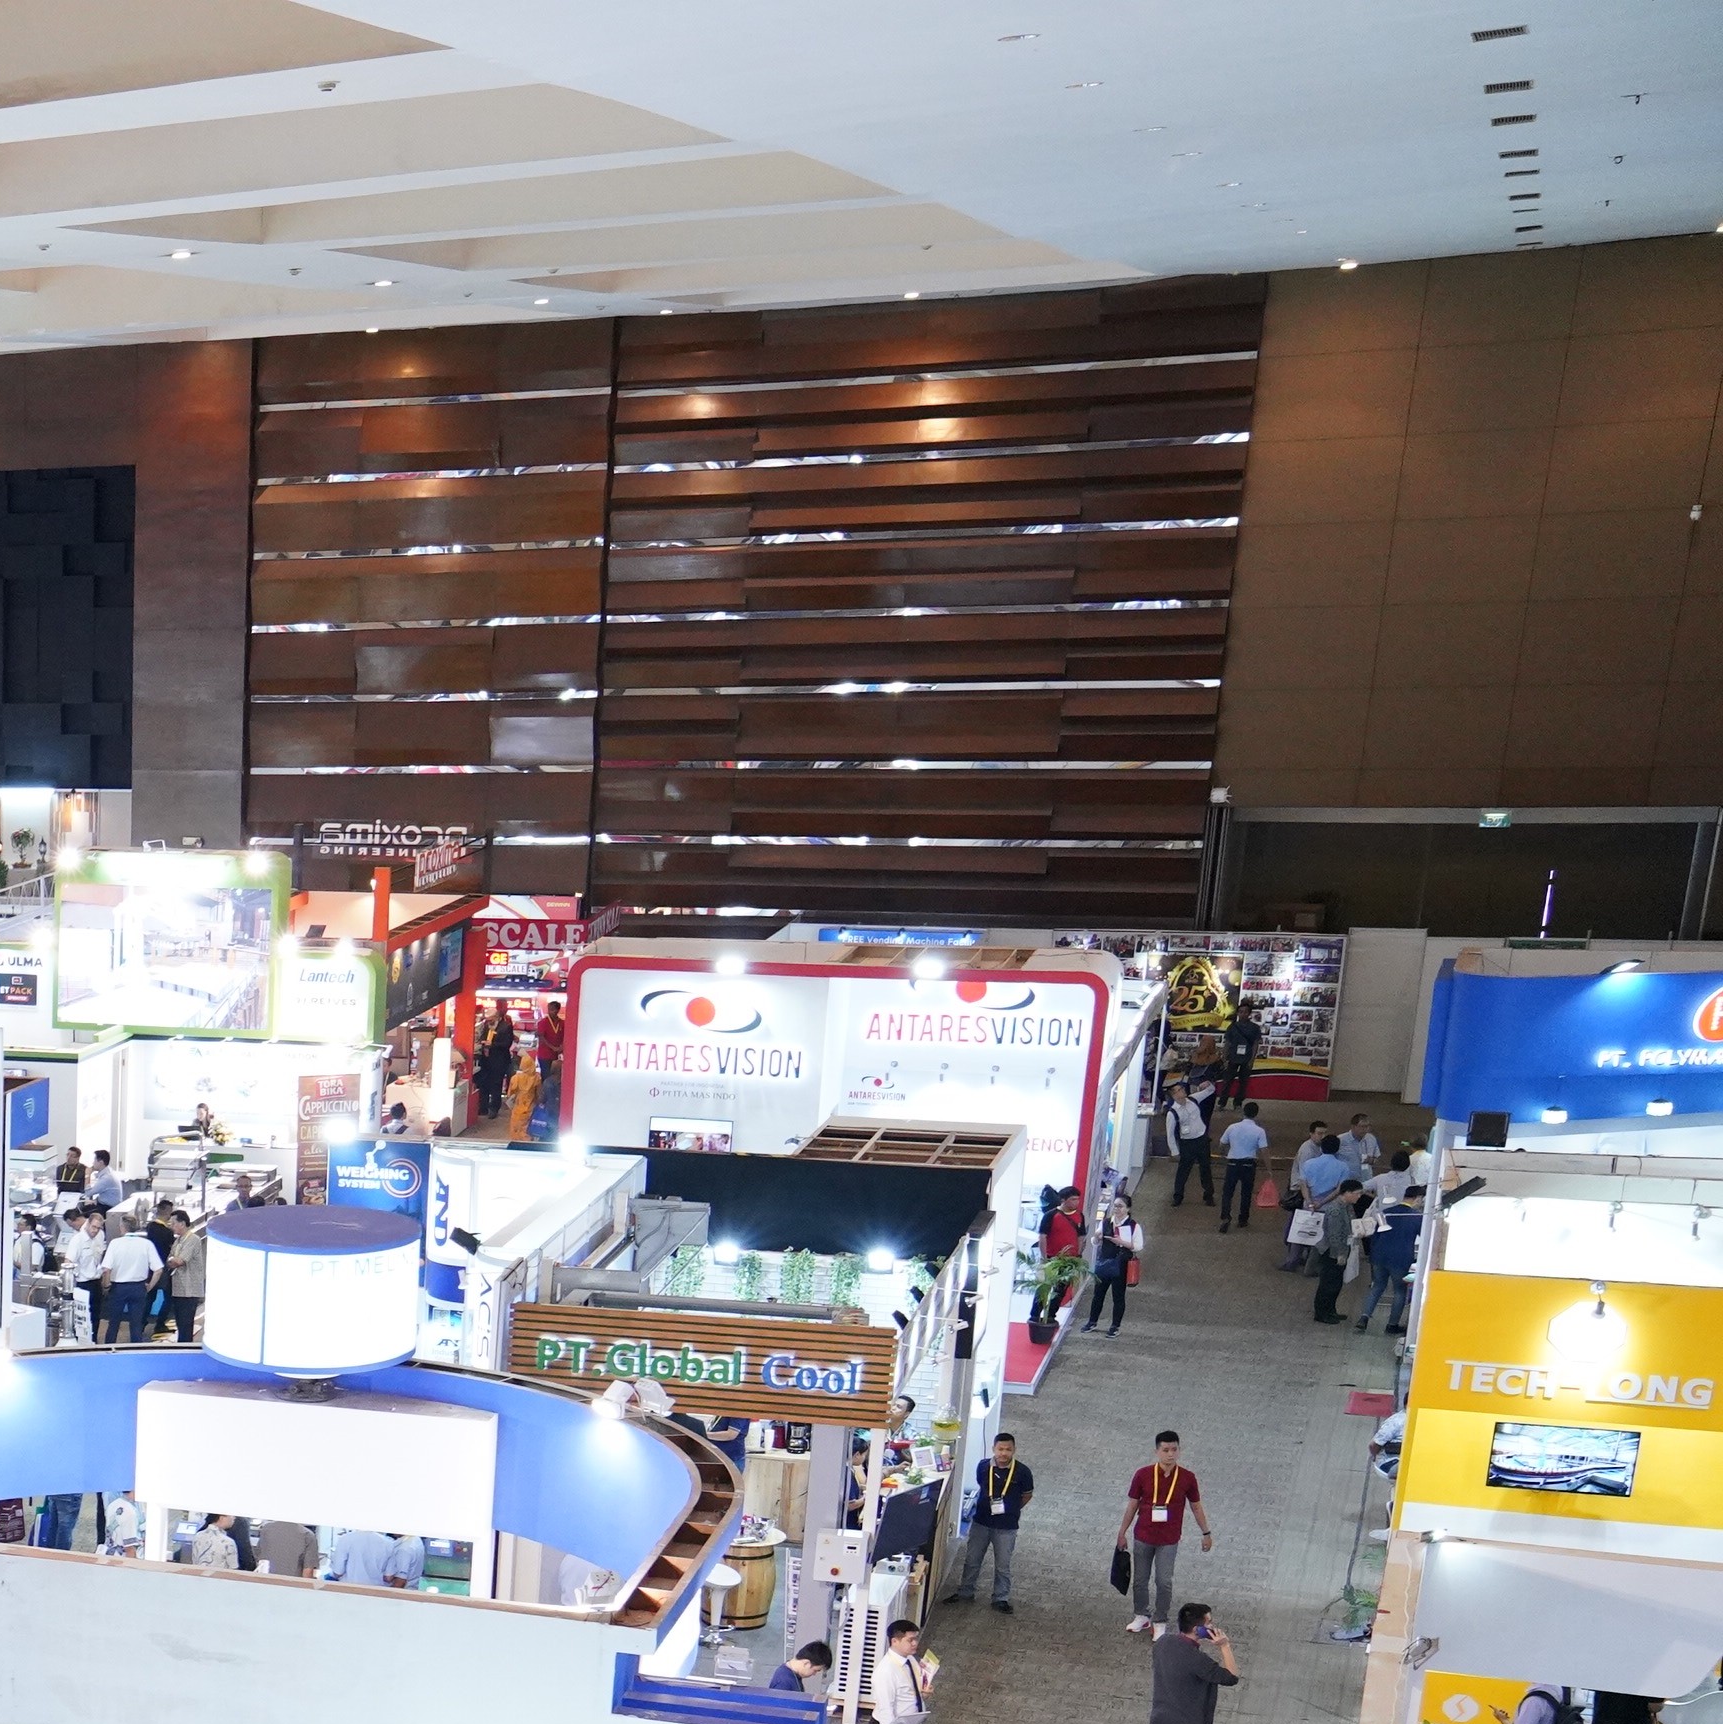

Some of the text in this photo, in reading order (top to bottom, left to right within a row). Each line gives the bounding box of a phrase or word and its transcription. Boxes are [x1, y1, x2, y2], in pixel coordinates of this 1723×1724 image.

[486, 922, 585, 950] SCALE
[906, 936, 945, 946] Machine
[7, 956, 43, 967] ULMA
[300, 968, 355, 984] Lantech
[318, 1079, 343, 1089] TORA
[319, 1087, 343, 1097] BIKA
[336, 1166, 409, 1182] WEIGHING
[338, 1179, 380, 1190] SYSTEM
[762, 1355, 863, 1397] Cool
